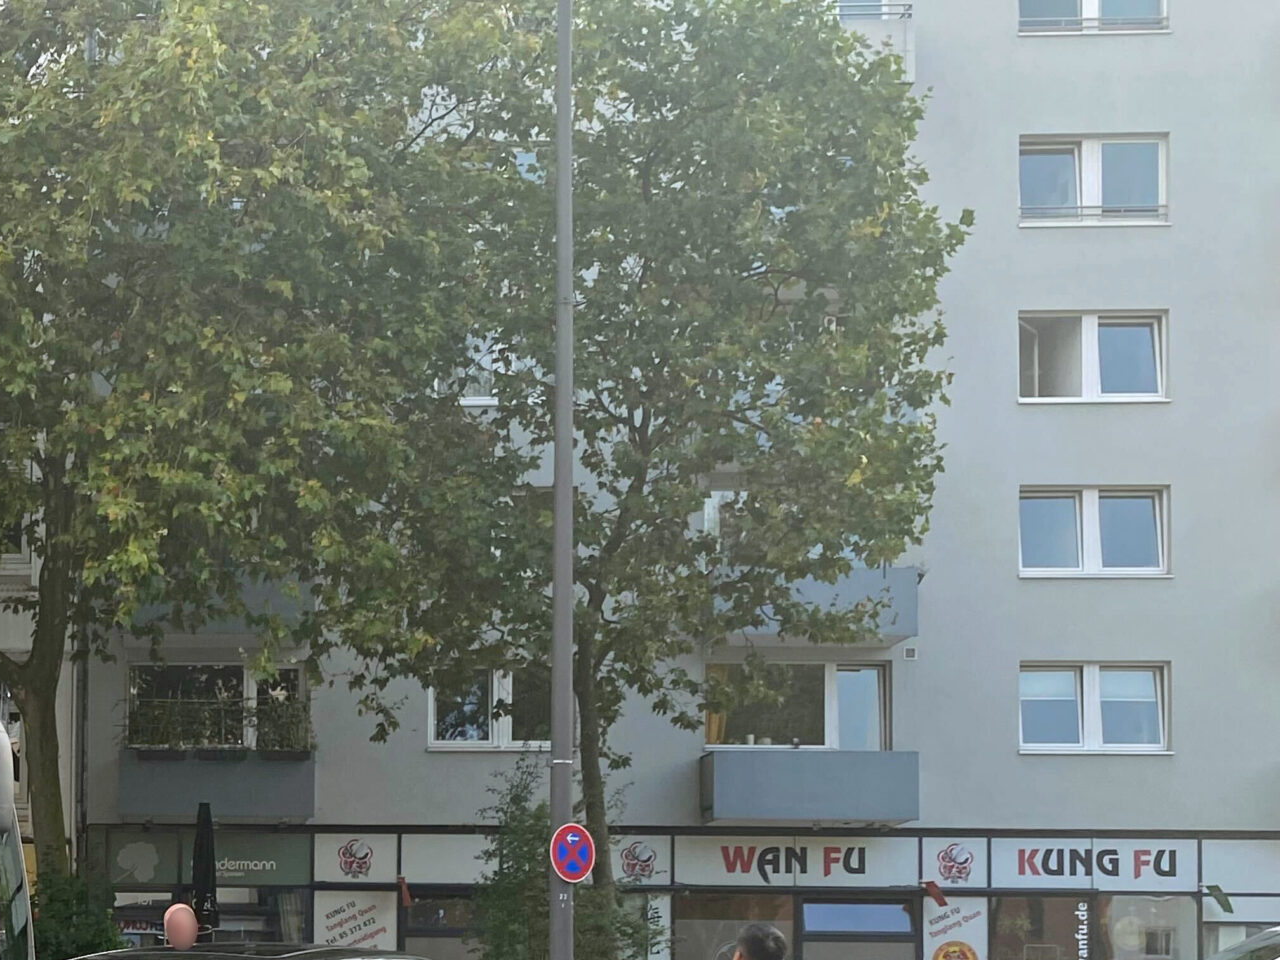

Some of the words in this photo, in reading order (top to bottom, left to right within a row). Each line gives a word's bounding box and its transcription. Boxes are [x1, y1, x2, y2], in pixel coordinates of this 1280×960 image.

[720, 845, 808, 885] WAN
[823, 846, 867, 879] FU
[1017, 847, 1120, 877] KUNG
[1133, 848, 1177, 881] FU
